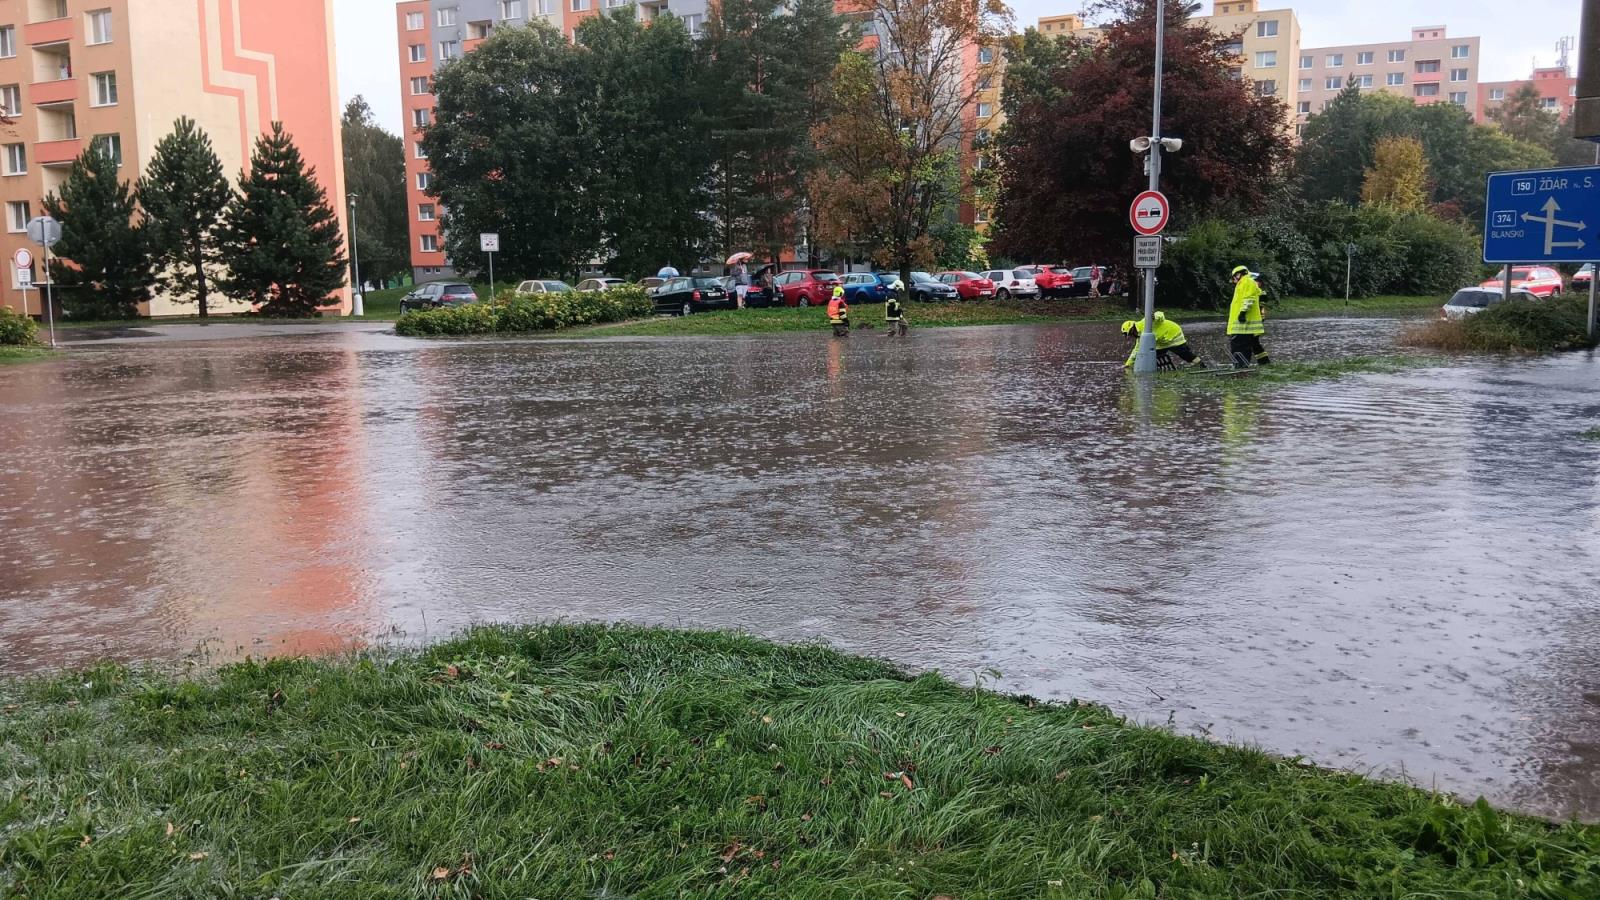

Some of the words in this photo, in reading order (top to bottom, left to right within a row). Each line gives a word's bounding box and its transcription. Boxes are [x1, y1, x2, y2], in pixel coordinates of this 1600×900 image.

[1517, 182, 1531, 190] 150
[1539, 177, 1568, 190] ŽĎÁR
[1583, 176, 1594, 188] S.
[1497, 214, 1512, 223] 374
[1491, 230, 1524, 238] BLANSKO
